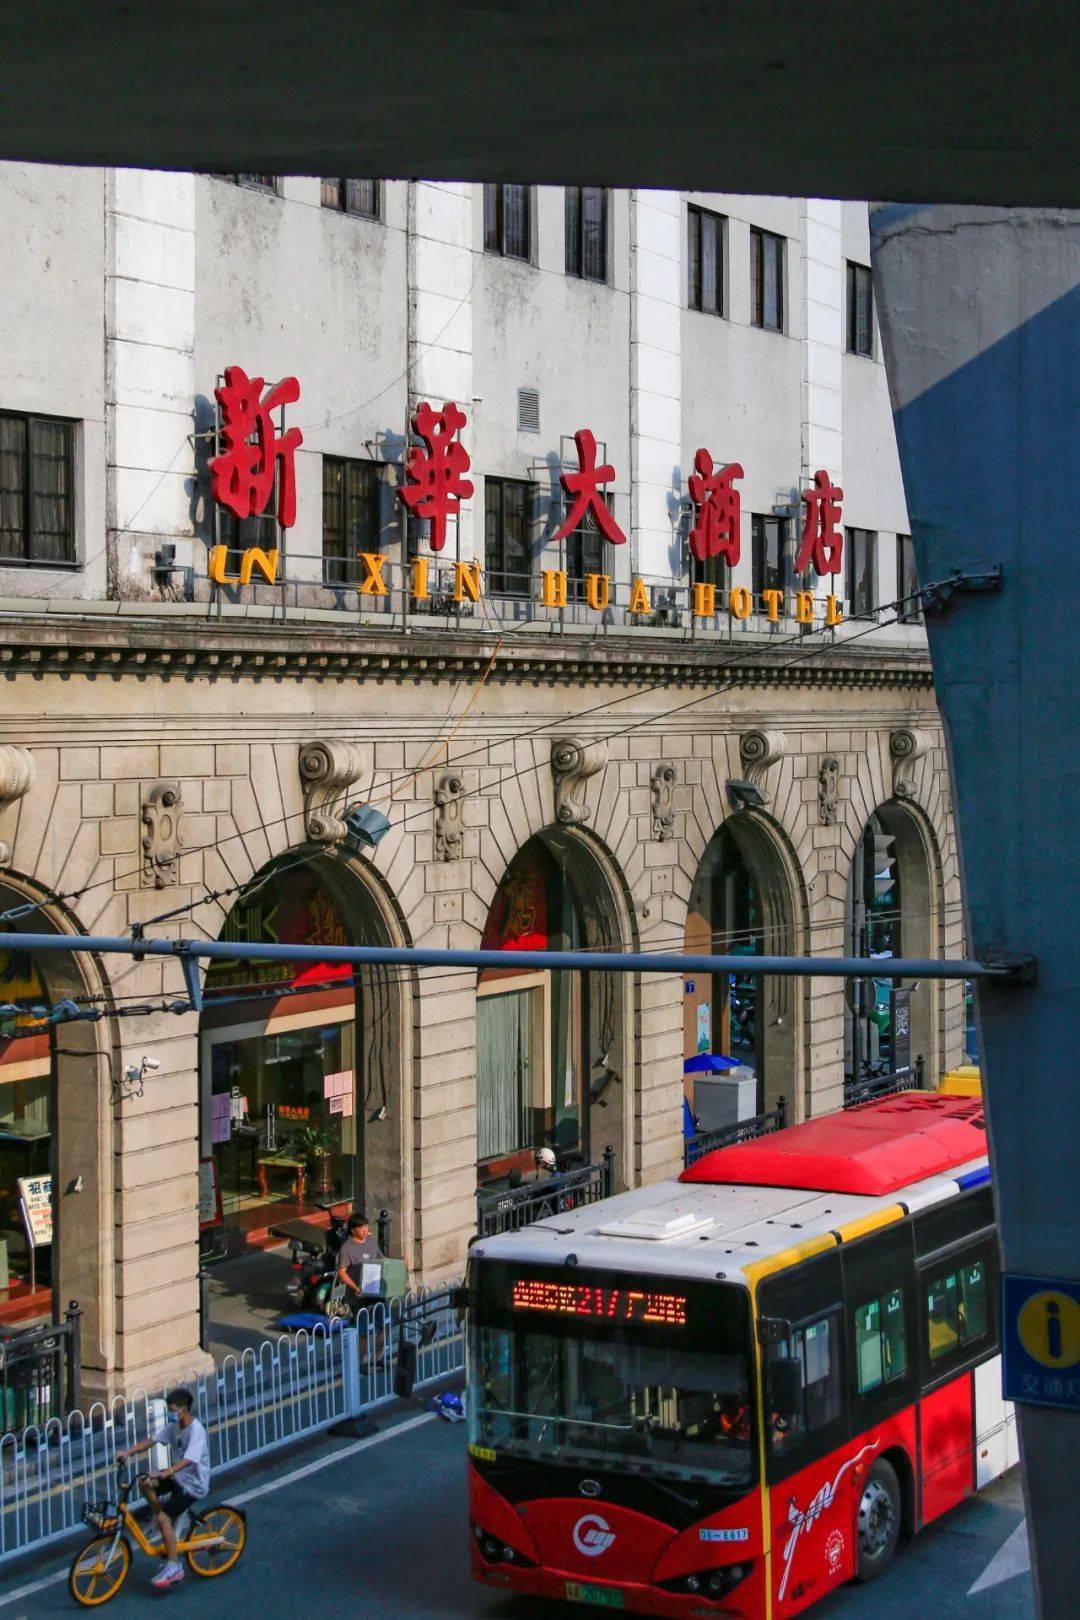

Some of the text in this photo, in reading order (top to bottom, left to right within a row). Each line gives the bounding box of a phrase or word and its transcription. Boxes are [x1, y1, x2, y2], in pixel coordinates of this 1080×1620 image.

[358, 552, 483, 603] XIN
[540, 569, 652, 615] HUA
[692, 582, 843, 626] HOTEL
